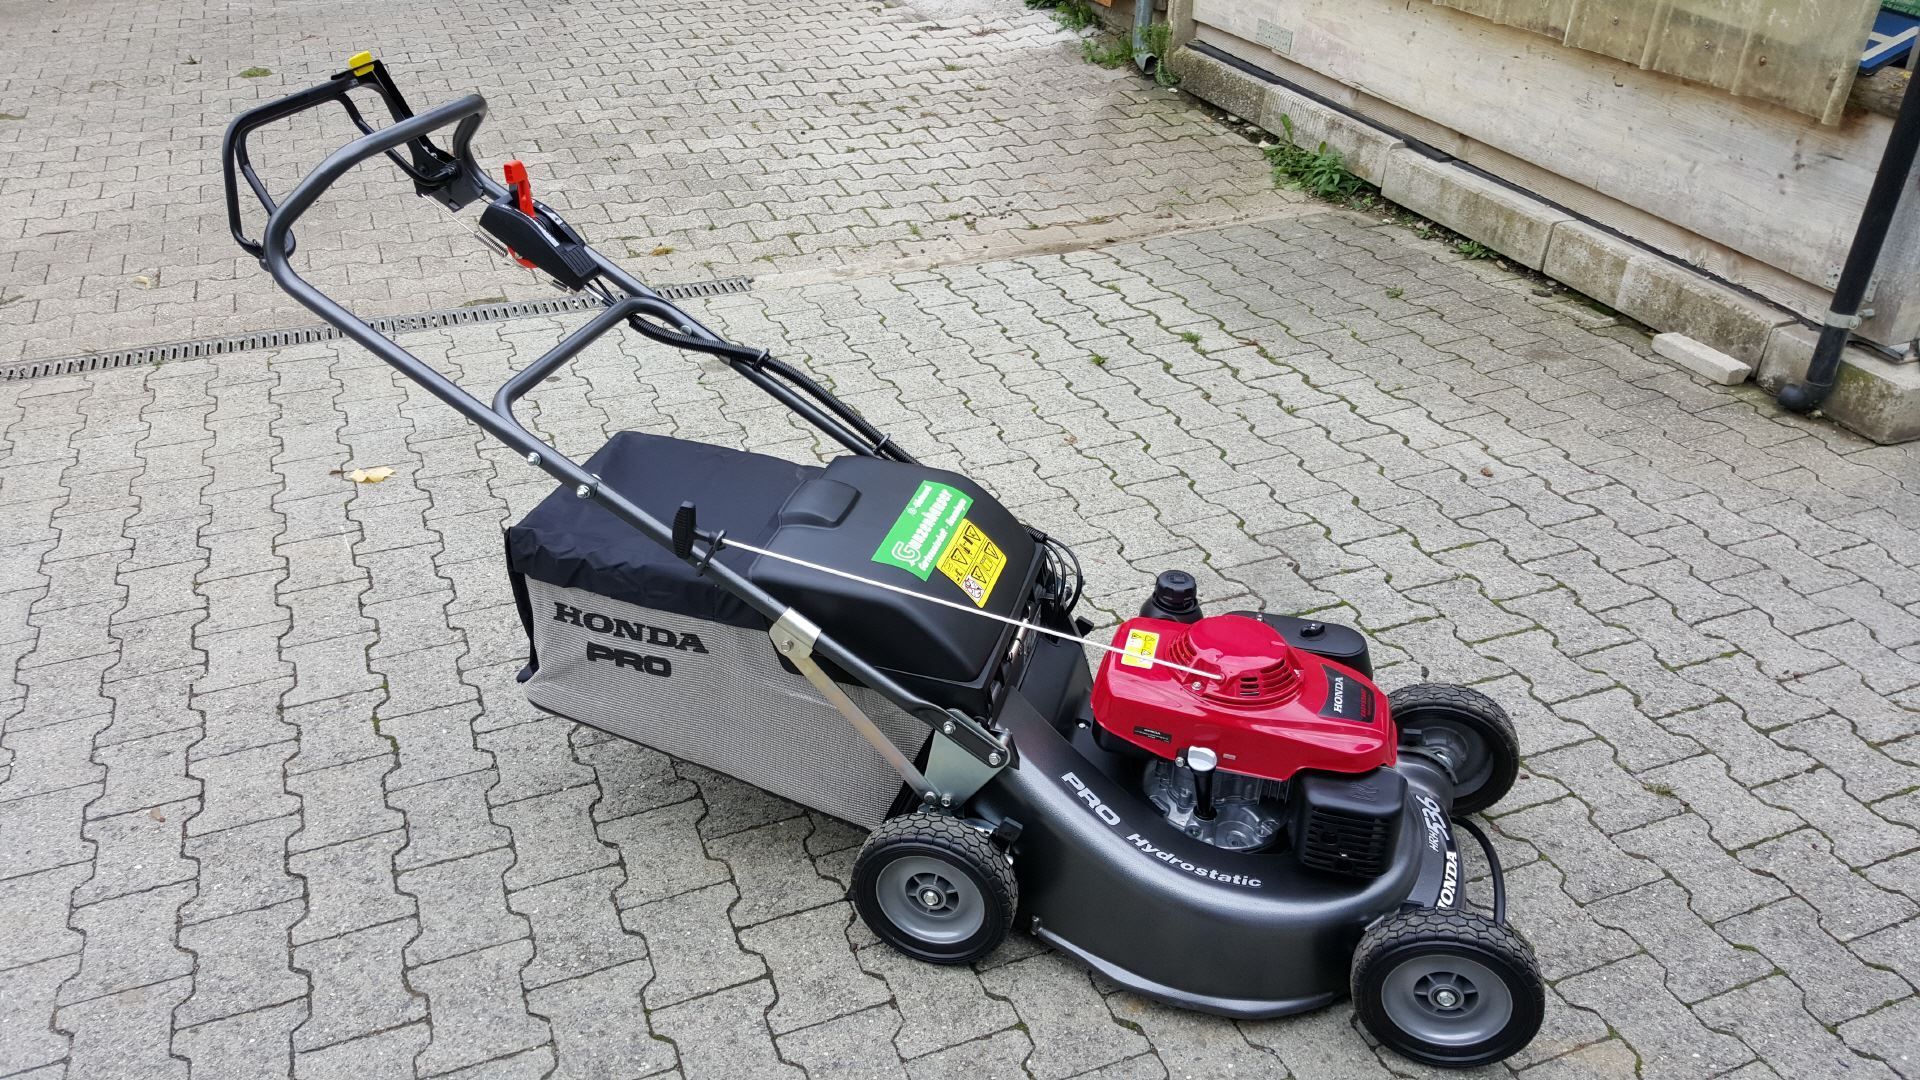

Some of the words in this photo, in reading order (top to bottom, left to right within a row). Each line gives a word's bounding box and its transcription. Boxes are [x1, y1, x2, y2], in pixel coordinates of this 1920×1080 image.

[553, 602, 710, 654] HONDA
[586, 641, 672, 678] PRO
[1333, 676, 1344, 714] HONDA
[1060, 771, 1121, 826] PRO
[1126, 833, 1263, 888] Hydrostatic
